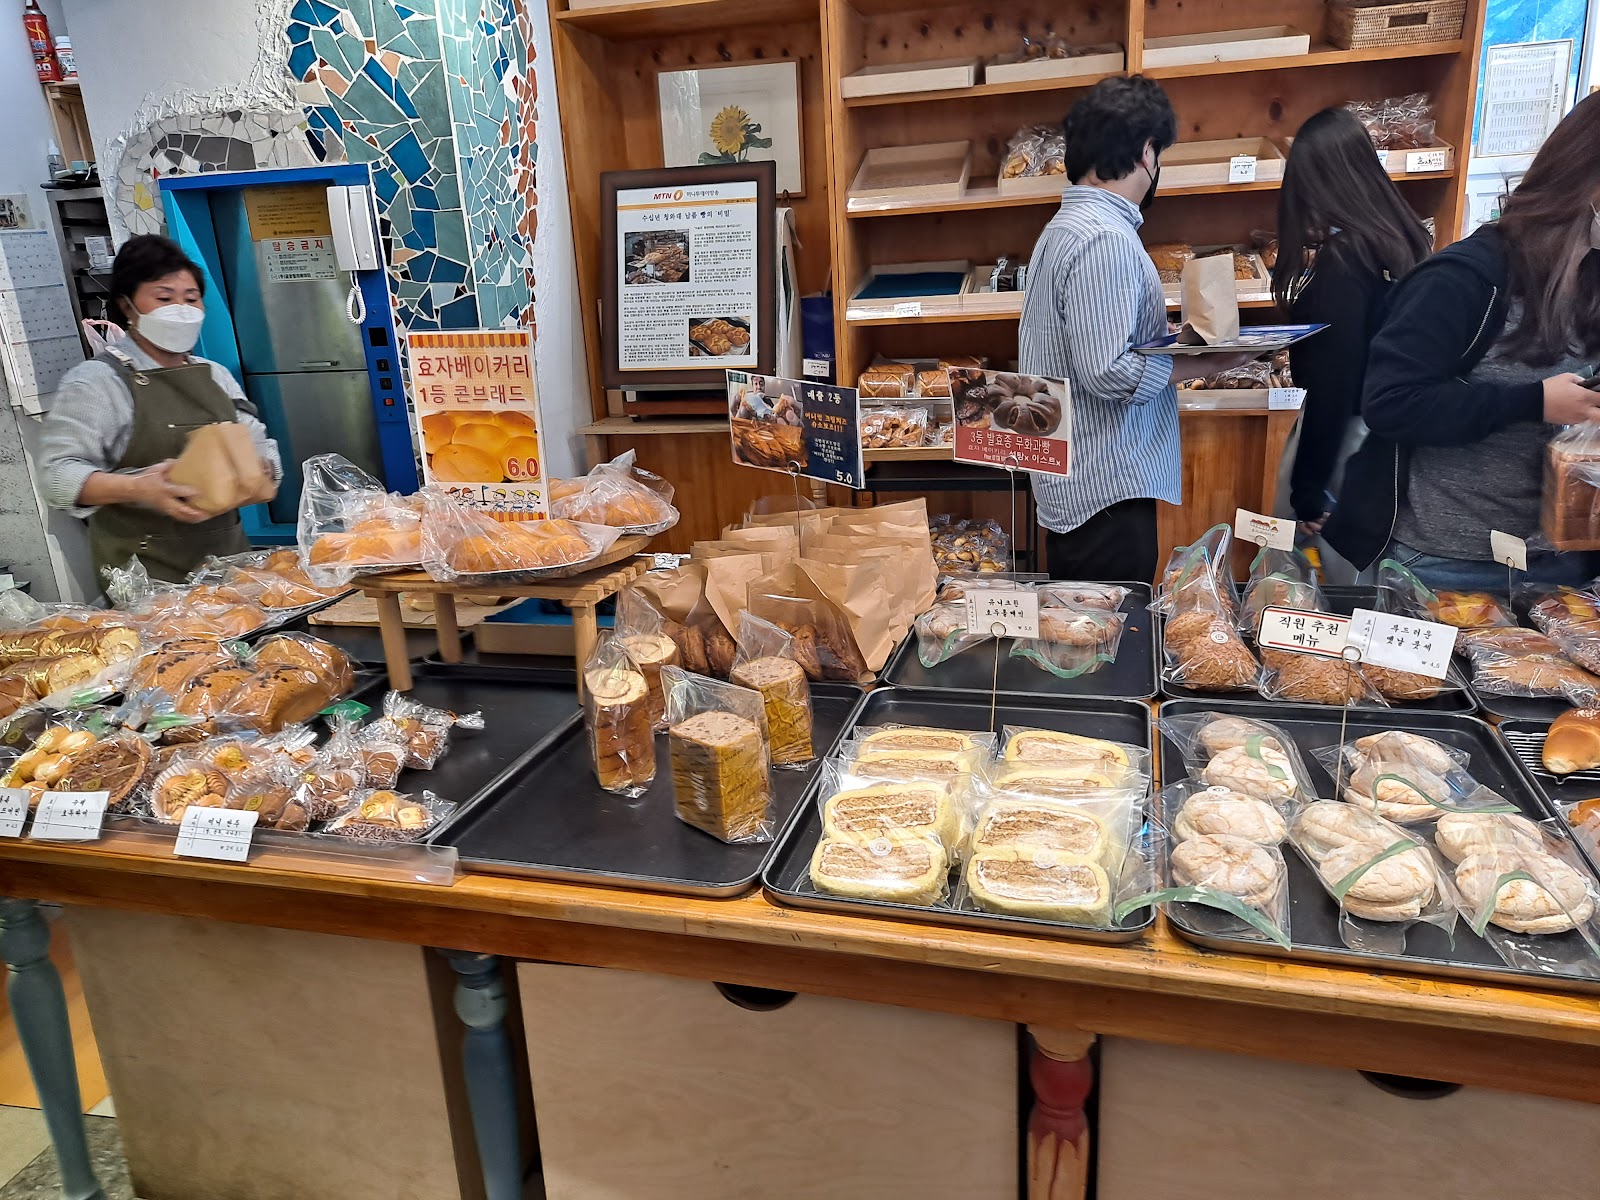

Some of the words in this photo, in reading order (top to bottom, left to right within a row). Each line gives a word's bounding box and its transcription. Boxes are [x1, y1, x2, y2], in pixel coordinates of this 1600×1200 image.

[653, 192, 672, 200] MTN
[641, 213, 660, 222] 수십년
[663, 212, 682, 221] 청와대
[685, 211, 697, 220] 납품
[700, 210, 713, 219] 빵의
[417, 354, 530, 379] 효자베이커리
[419, 384, 446, 404] 1등
[453, 384, 527, 405] 콘브래드
[807, 389, 824, 402] 매출
[828, 392, 842, 405] 2등
[804, 411, 823, 421] 어니언
[824, 414, 848, 425] 크림치즈
[970, 430, 984, 445] 3등
[986, 431, 1013, 449] 발효종
[1015, 436, 1051, 454] 무화과빵
[507, 457, 539, 477] 6.0
[1031, 454, 1061, 467] 이스트x
[835, 469, 853, 485] 5.0
[1279, 615, 1306, 631] 직원
[1311, 619, 1339, 636] 추천
[1292, 632, 1320, 648] 메뉴
[1429, 661, 1440, 669] 4.5
